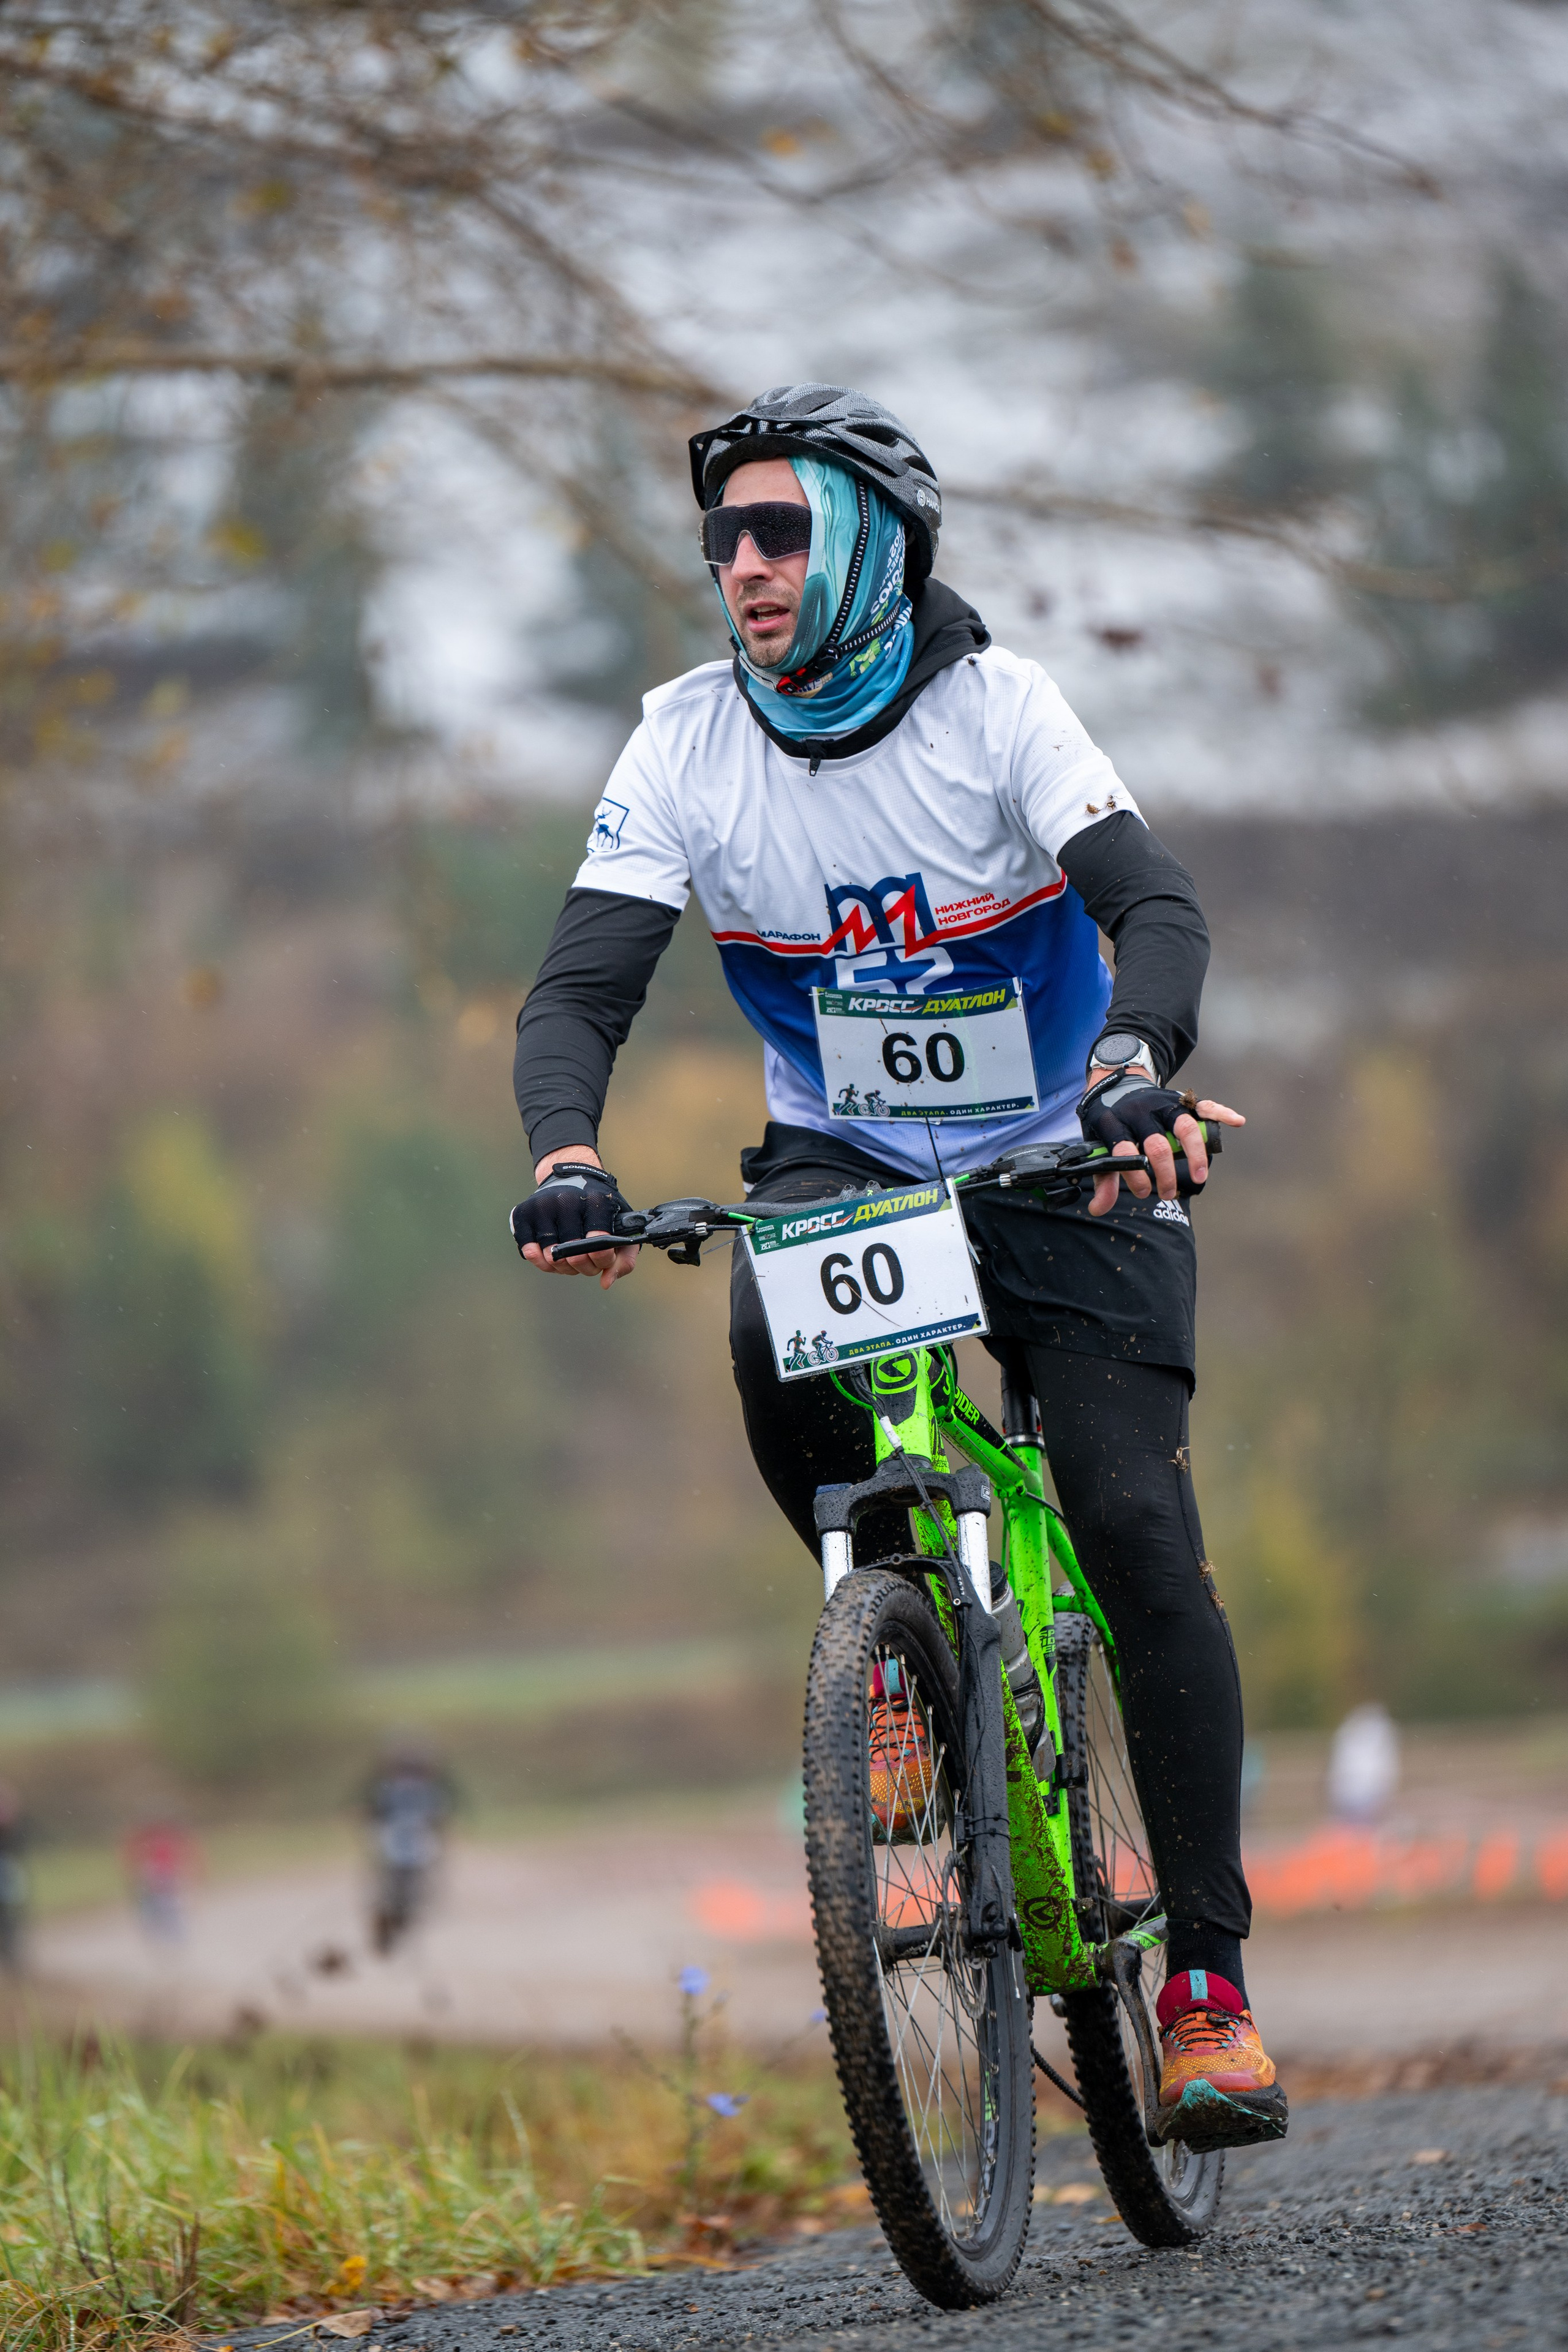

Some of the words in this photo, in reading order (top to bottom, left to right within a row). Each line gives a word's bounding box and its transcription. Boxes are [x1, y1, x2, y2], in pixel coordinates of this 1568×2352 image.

[935, 892, 995, 914] НИЖНИЙ
[938, 898, 1011, 925] НОВГОРОД
[756, 929, 821, 940] МАРАФОН
[848, 997, 922, 1014] КРОСС
[922, 989, 1006, 1014] ДУАТЛОН
[882, 1032, 965, 1083] 60
[974, 1103, 1020, 1113] ХАРАКТЕР.
[562, 1165, 608, 1178] ROCKBROS
[782, 1210, 854, 1240] КРОСС
[853, 1188, 938, 1225] ДУАТЛОН
[1153, 1207, 1189, 1227] adidas
[821, 1243, 904, 1315] 60
[866, 1341, 894, 1351] ЭТАПА.
[895, 1334, 918, 1344] ОДИН
[921, 1324, 966, 1338] ХАРАКТЕР.
